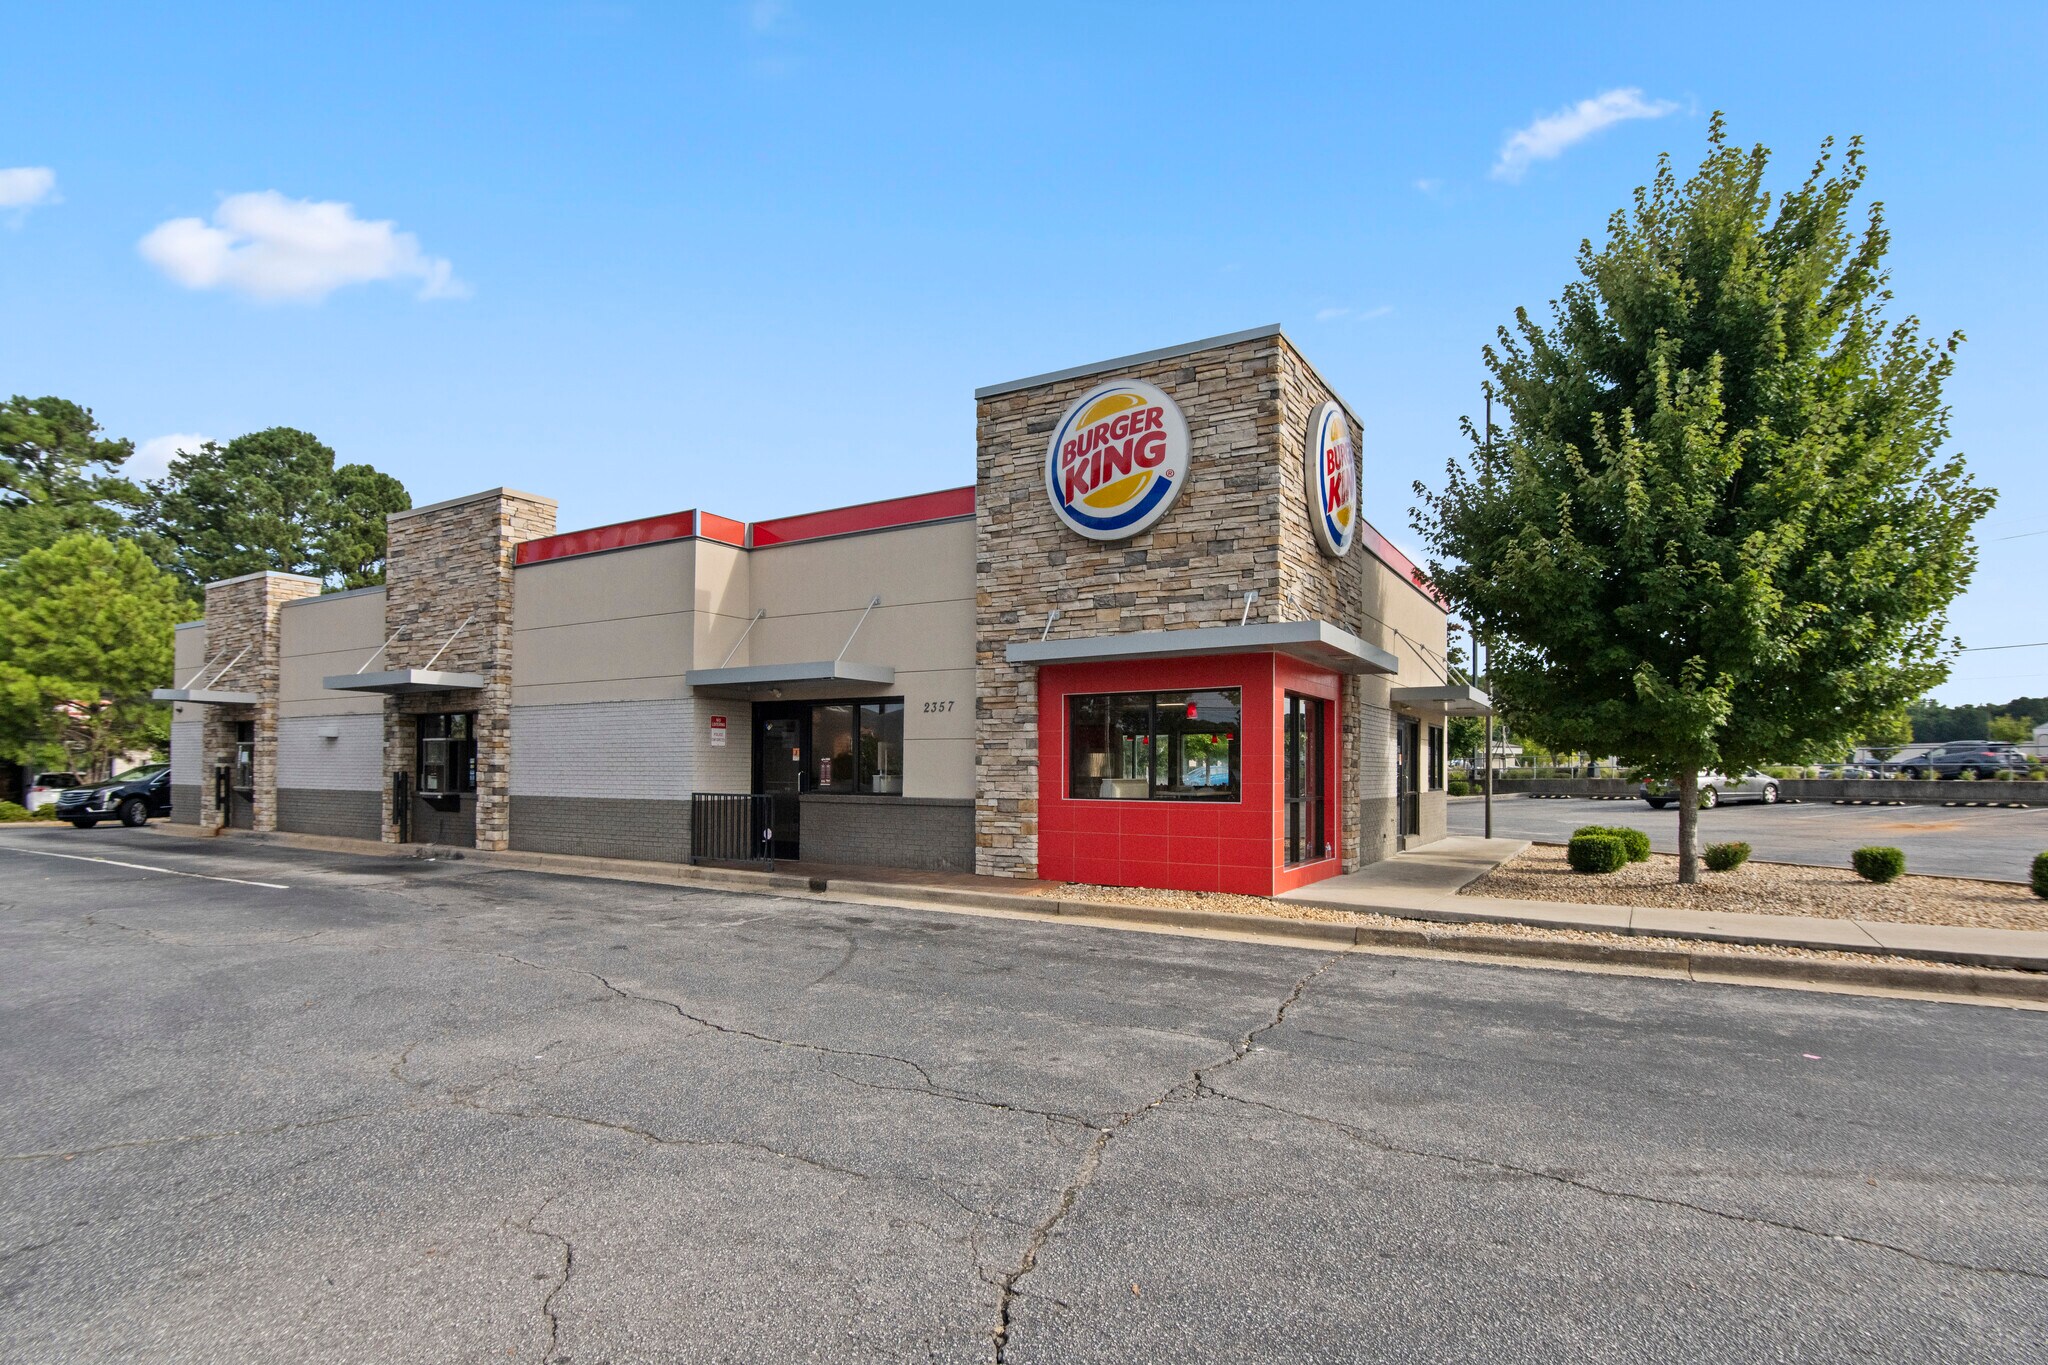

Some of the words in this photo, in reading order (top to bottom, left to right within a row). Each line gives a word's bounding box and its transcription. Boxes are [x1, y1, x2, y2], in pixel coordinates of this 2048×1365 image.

[1062, 406, 1164, 470] BURGER
[1065, 430, 1167, 506] KING
[923, 701, 955, 713] 2357
